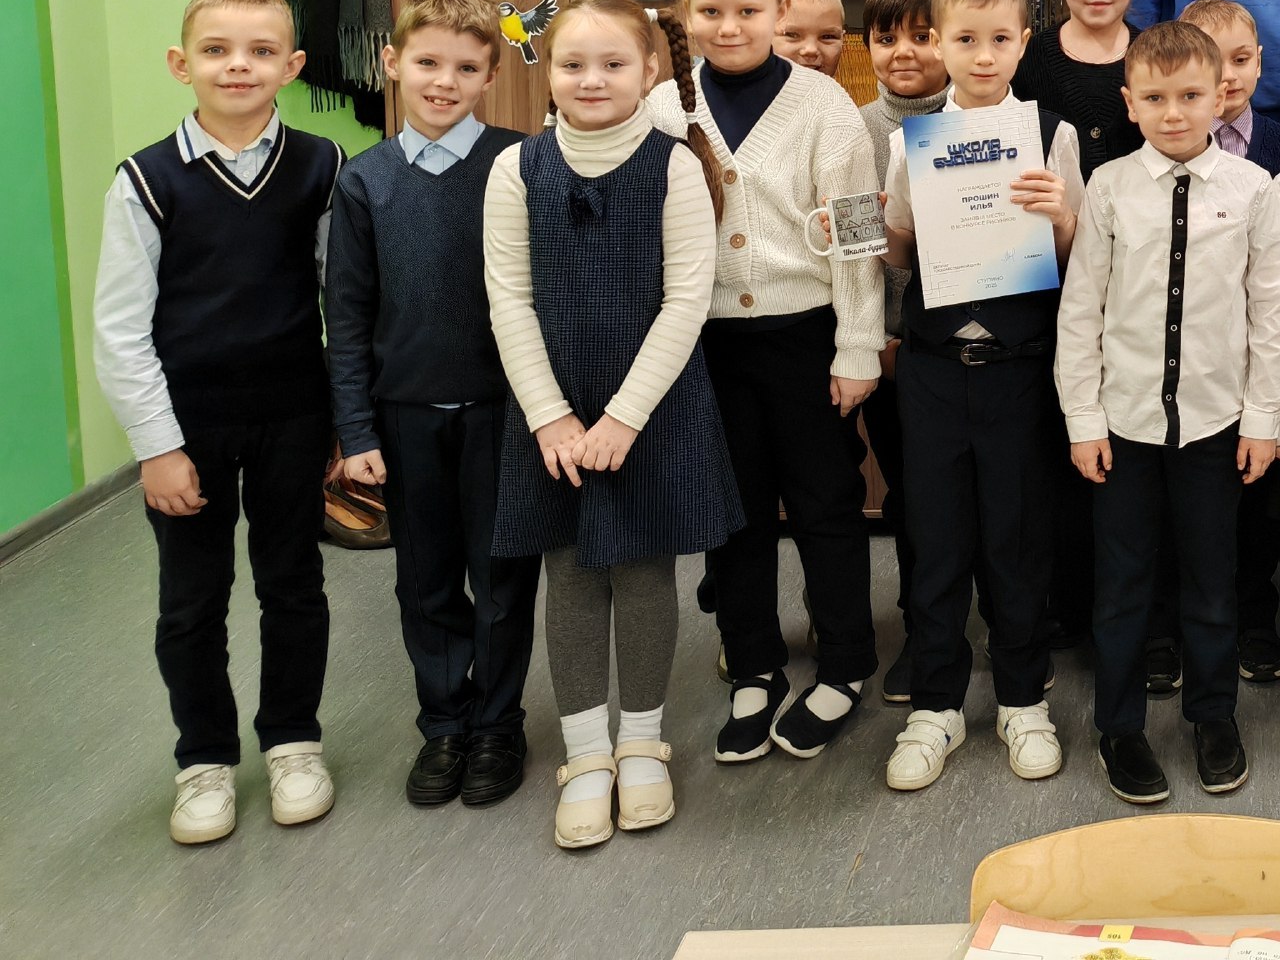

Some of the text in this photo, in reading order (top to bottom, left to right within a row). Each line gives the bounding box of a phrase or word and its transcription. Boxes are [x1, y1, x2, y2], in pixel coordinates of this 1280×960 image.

[946, 138, 1001, 155] ШКОЛА
[933, 147, 1018, 169] БУДУЩЕГО
[961, 192, 1000, 204] ПРОШИН
[969, 202, 993, 211] ИЛЬЯ
